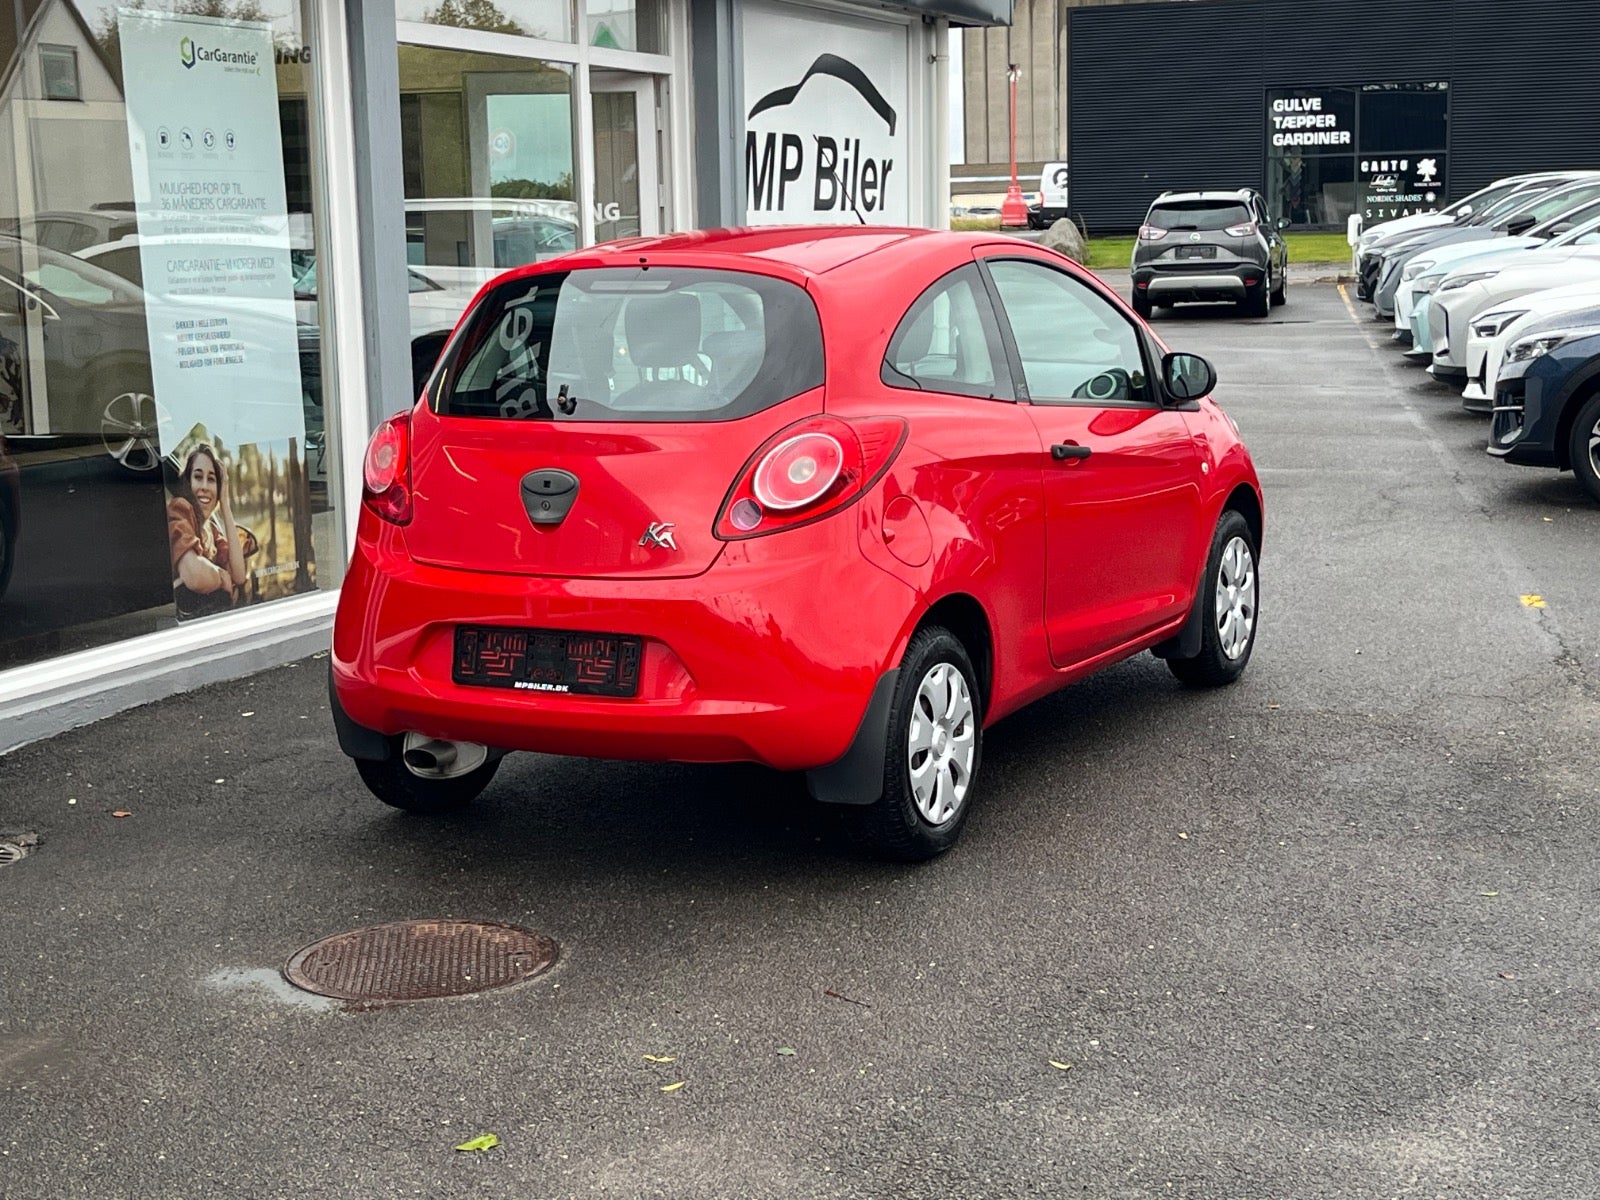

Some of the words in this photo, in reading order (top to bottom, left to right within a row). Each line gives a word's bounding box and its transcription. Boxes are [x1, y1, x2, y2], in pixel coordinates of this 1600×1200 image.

[1273, 97, 1322, 112] GULVE
[1273, 114, 1336, 129] TÆPPER
[1272, 131, 1351, 146] GARDINER
[746, 130, 803, 211] MP
[814, 136, 893, 212] Biler
[203, 182, 219, 195] FOR
[221, 182, 231, 195] OP
[1366, 195, 1394, 203] NORDIC
